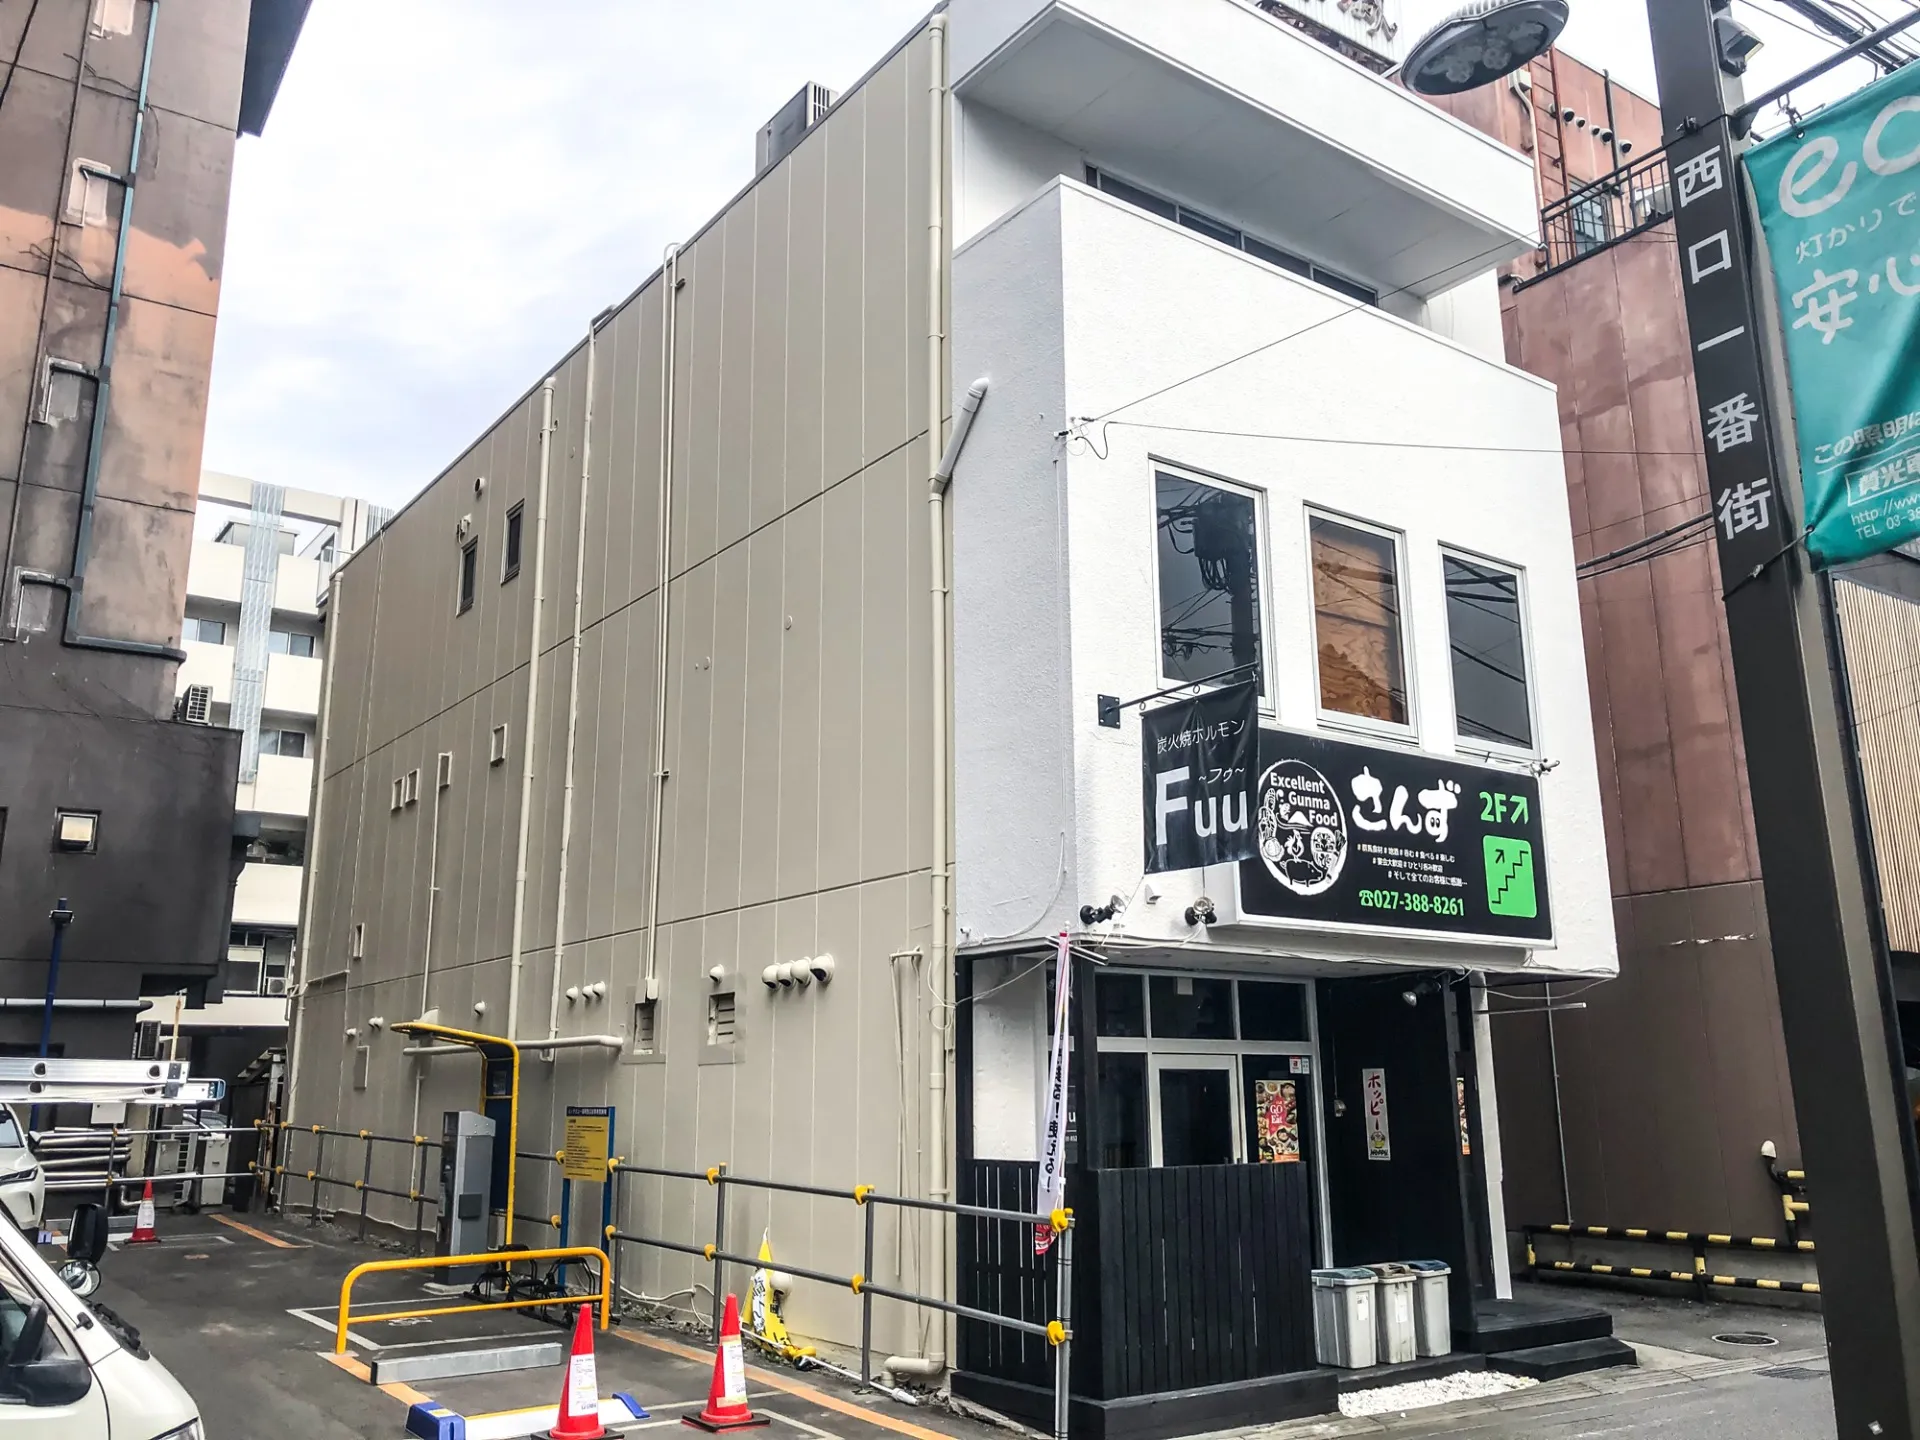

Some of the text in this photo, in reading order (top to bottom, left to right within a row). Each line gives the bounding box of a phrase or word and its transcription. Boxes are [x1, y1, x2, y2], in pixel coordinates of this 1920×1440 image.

[1674, 145, 1771, 540] 西口一番街
[1856, 524, 1879, 540] TEL
[1157, 720, 1245, 754] 炭火焼ホルモン
[1270, 772, 1325, 794] Excellent
[1155, 766, 1248, 846] Fuu
[1288, 791, 1331, 810] Gunma
[1351, 766, 1461, 842] さんず
[1479, 791, 1507, 823] 2F
[1308, 809, 1338, 827] Food
[1374, 889, 1465, 916] 027-388-8261
[1368, 1072, 1384, 1130] ホッピー
